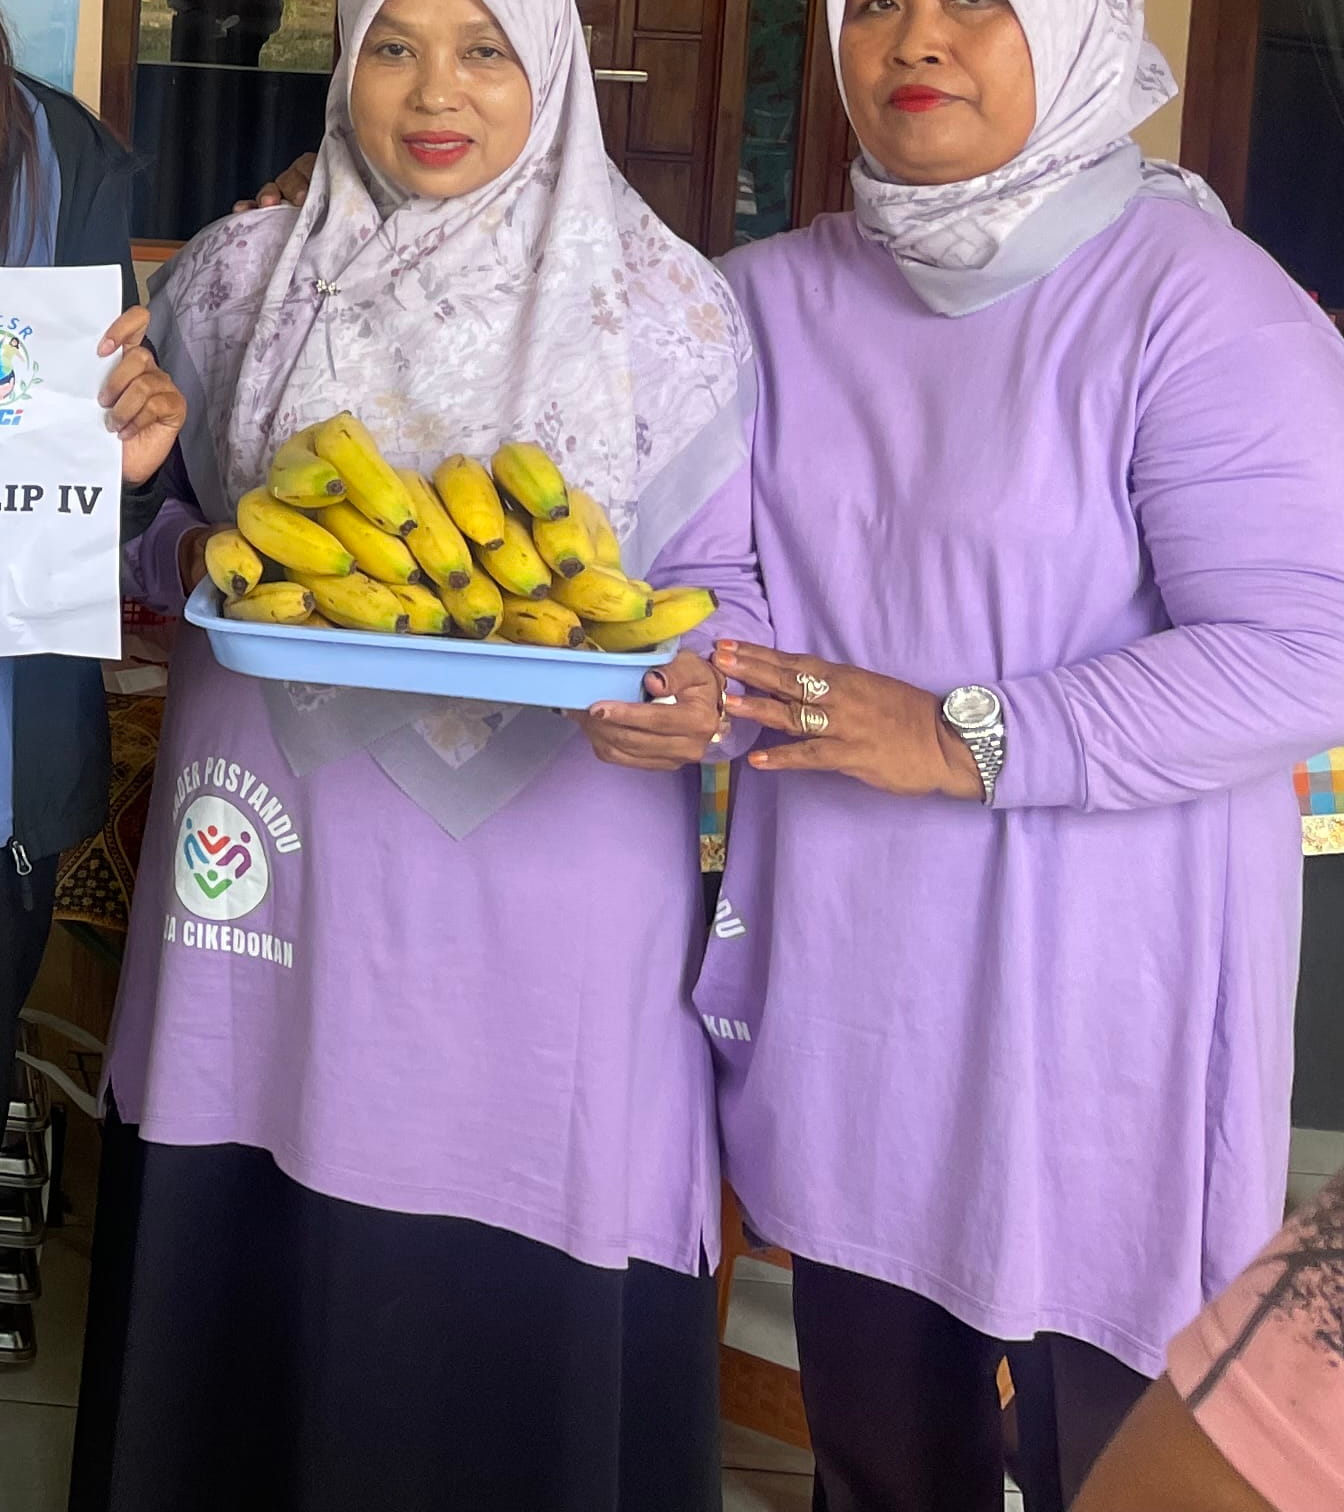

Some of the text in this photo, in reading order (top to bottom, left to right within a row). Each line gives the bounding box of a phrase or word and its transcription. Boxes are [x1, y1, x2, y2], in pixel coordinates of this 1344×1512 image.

[56, 485, 103, 516] IV
[204, 756, 302, 854] POSYANDU
[182, 920, 293, 969] CIKEDOKAN
